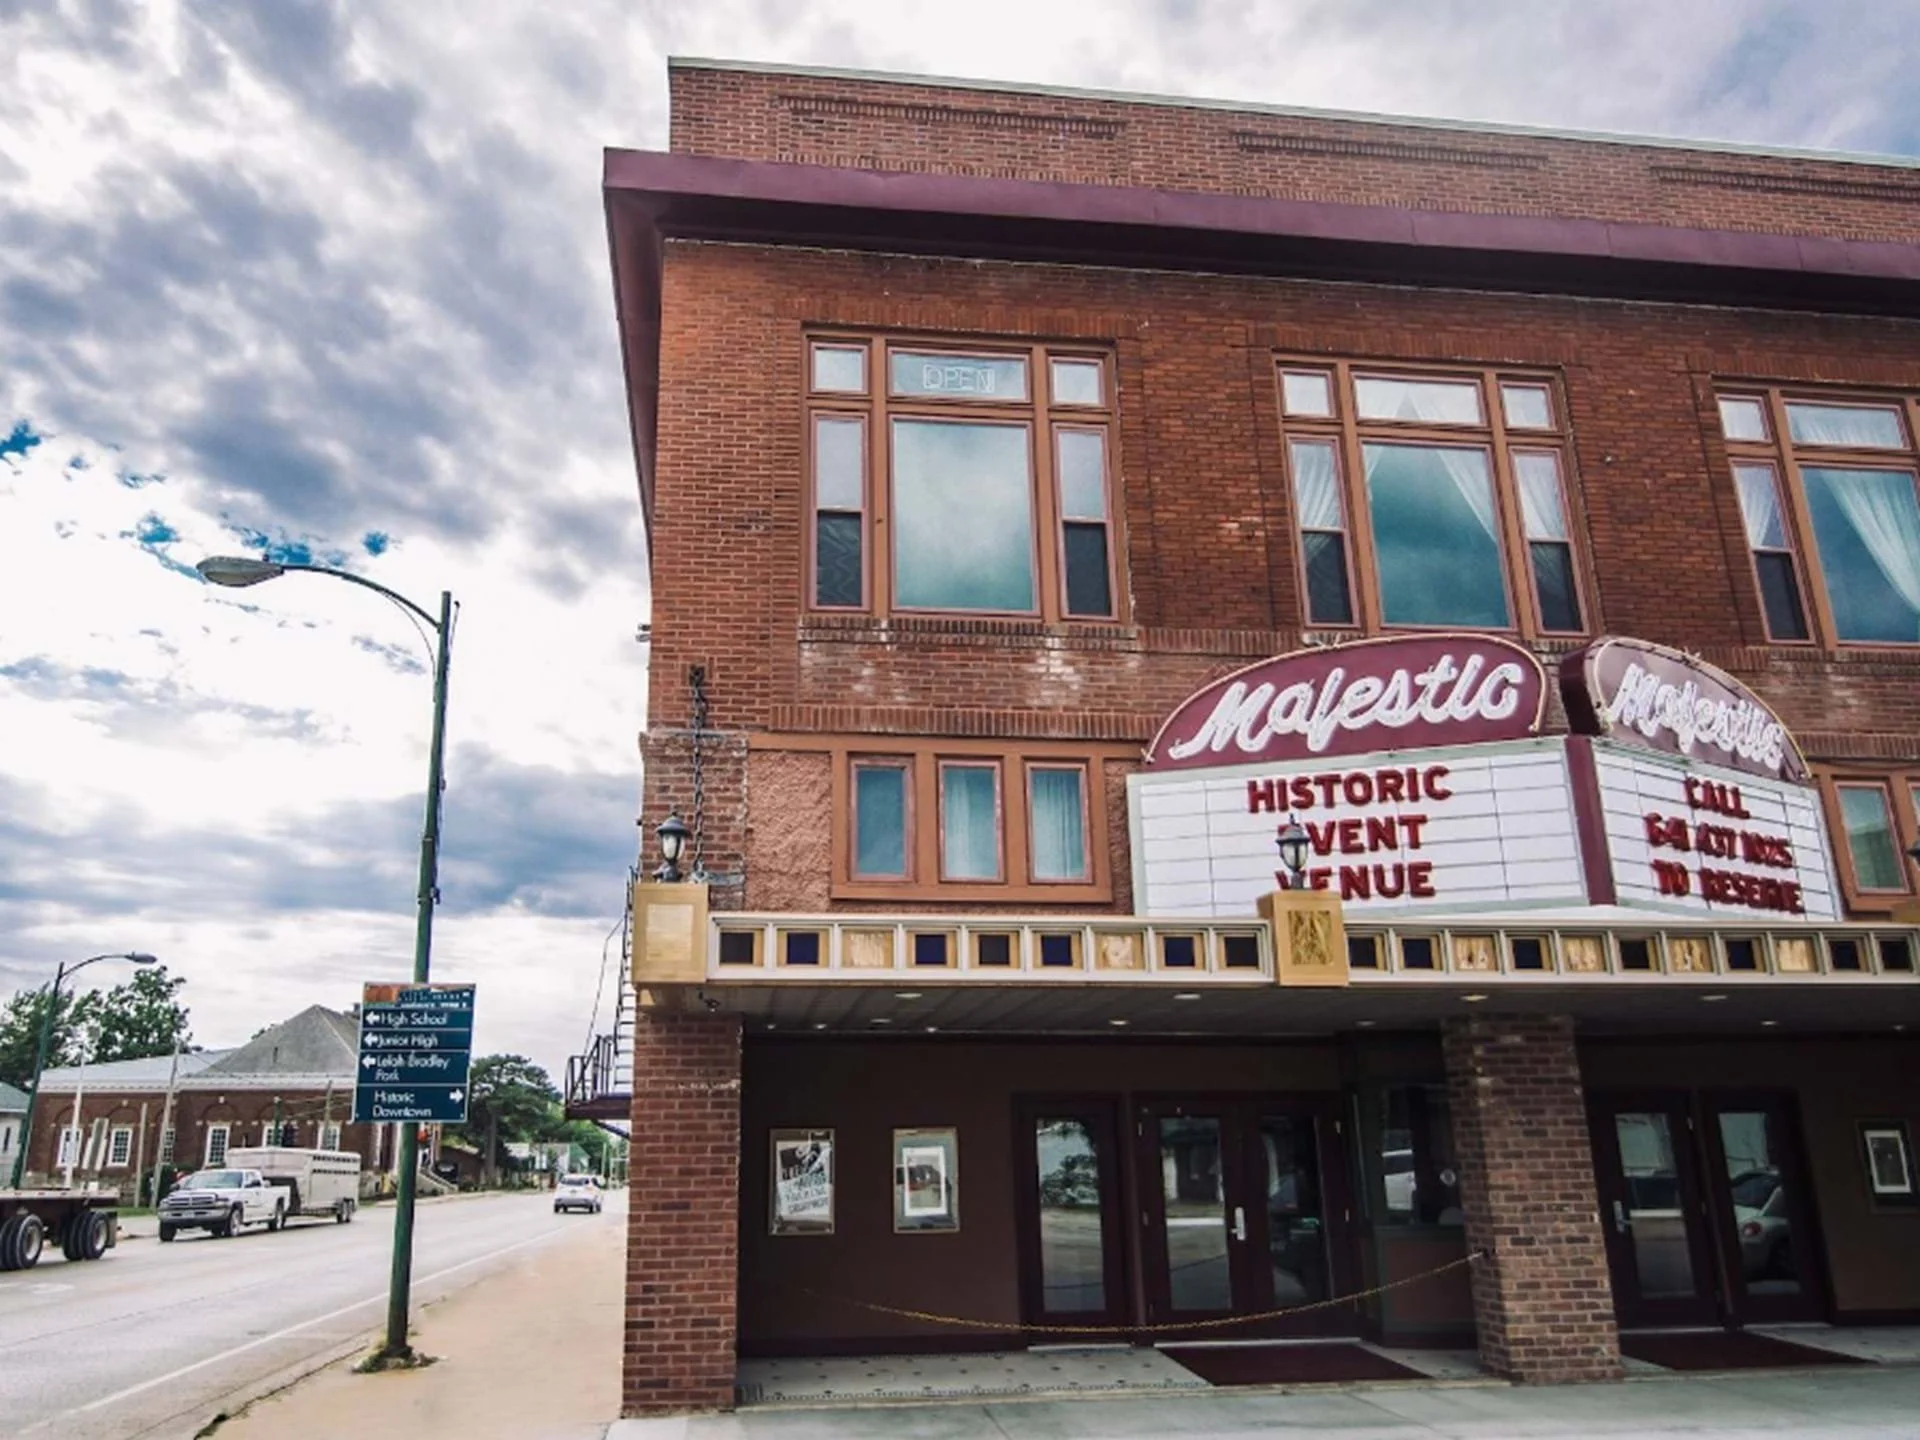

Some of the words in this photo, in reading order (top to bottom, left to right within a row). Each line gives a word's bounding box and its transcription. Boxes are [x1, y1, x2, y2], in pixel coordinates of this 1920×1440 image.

[925, 365, 995, 392] OPEN
[1168, 654, 1525, 761] Majestic
[1247, 766, 1453, 813] HISTORIC
[1684, 776, 1750, 819] CALL
[1651, 859, 1691, 897] TO
[1698, 868, 1805, 915] RESERVE
[381, 1012, 408, 1029] High
[411, 1012, 448, 1025] School
[377, 1035, 408, 1047] Junior
[411, 1034, 438, 1048] High
[375, 1069, 400, 1081] Park
[374, 1090, 415, 1103] Historic
[372, 1105, 432, 1117] Downtown
